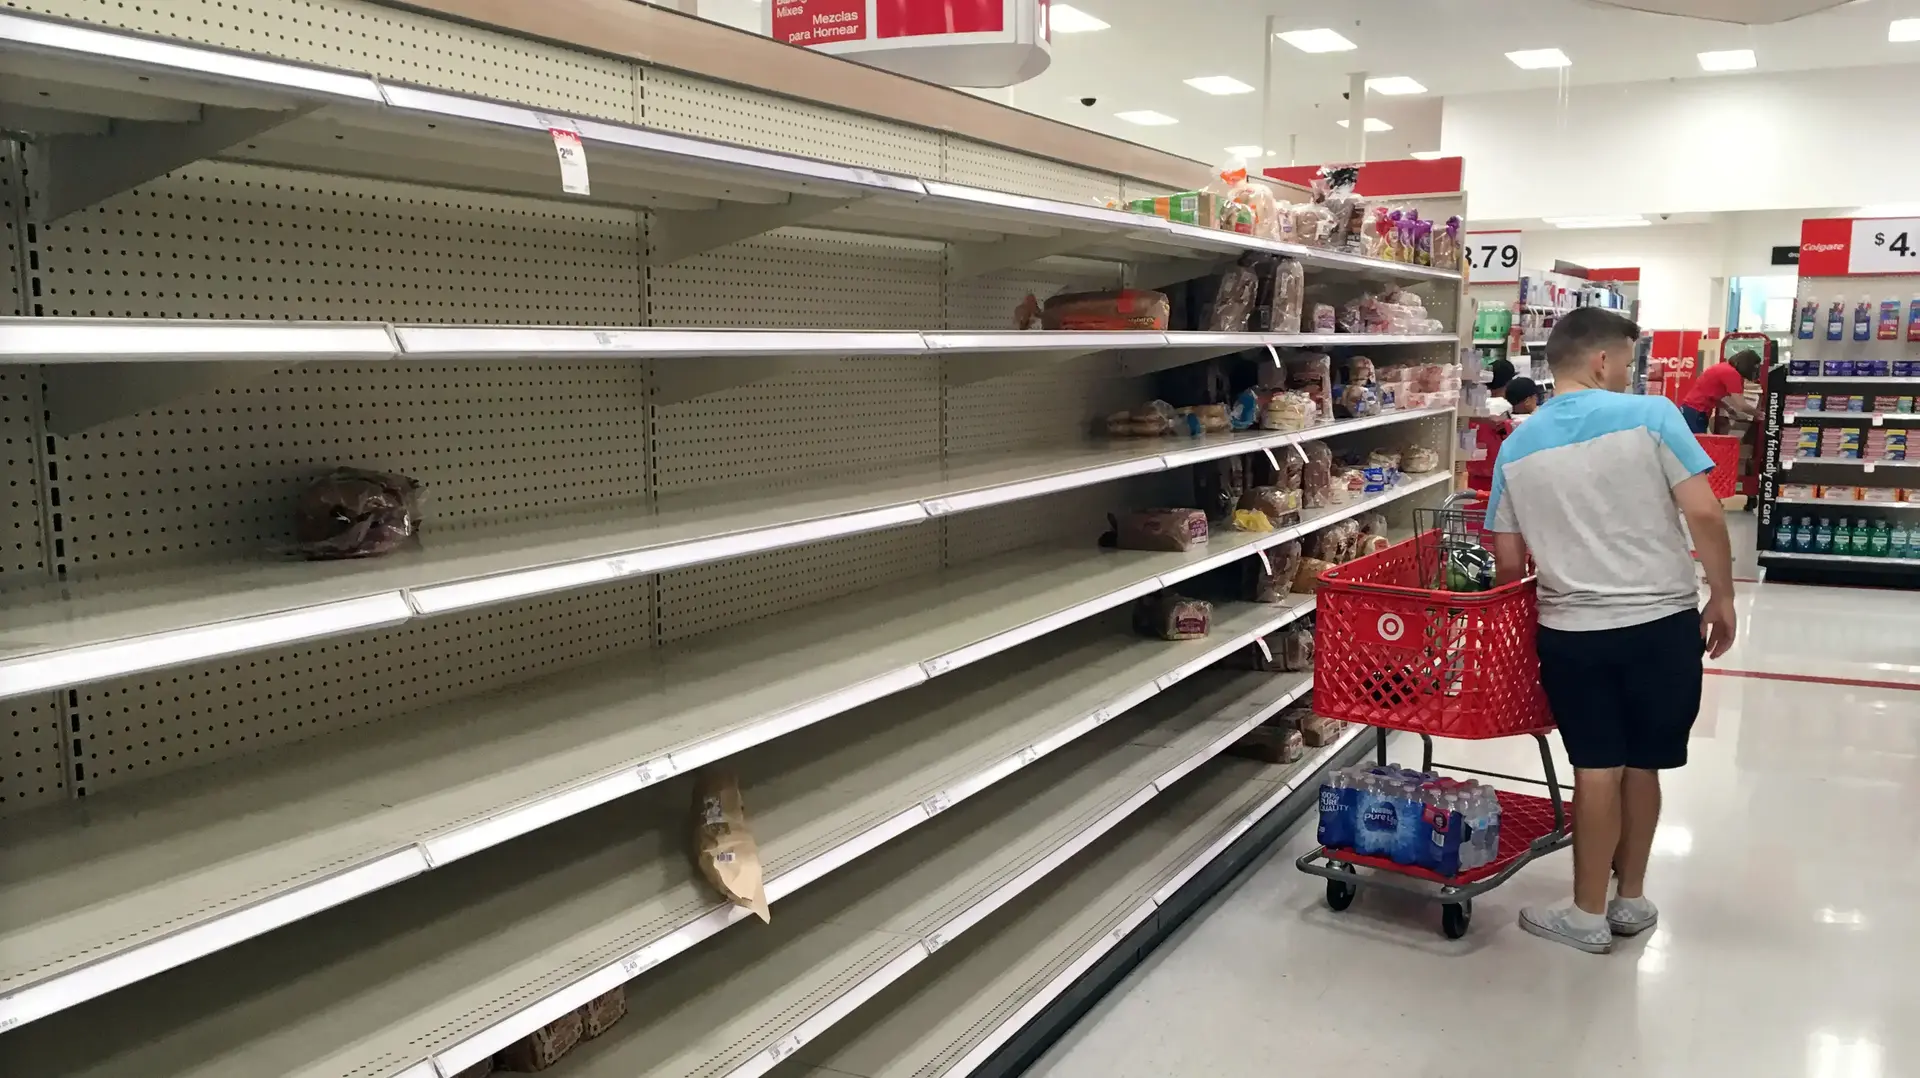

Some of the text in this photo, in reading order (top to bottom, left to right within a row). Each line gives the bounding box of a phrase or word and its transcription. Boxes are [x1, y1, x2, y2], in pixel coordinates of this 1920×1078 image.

[777, 6, 804, 18] Mixes
[813, 11, 859, 25] Mezclas
[789, 25, 859, 43] para Hornear
[1802, 243, 1845, 252] Colgate
[1763, 392, 1779, 525] naturally friendly oral care
